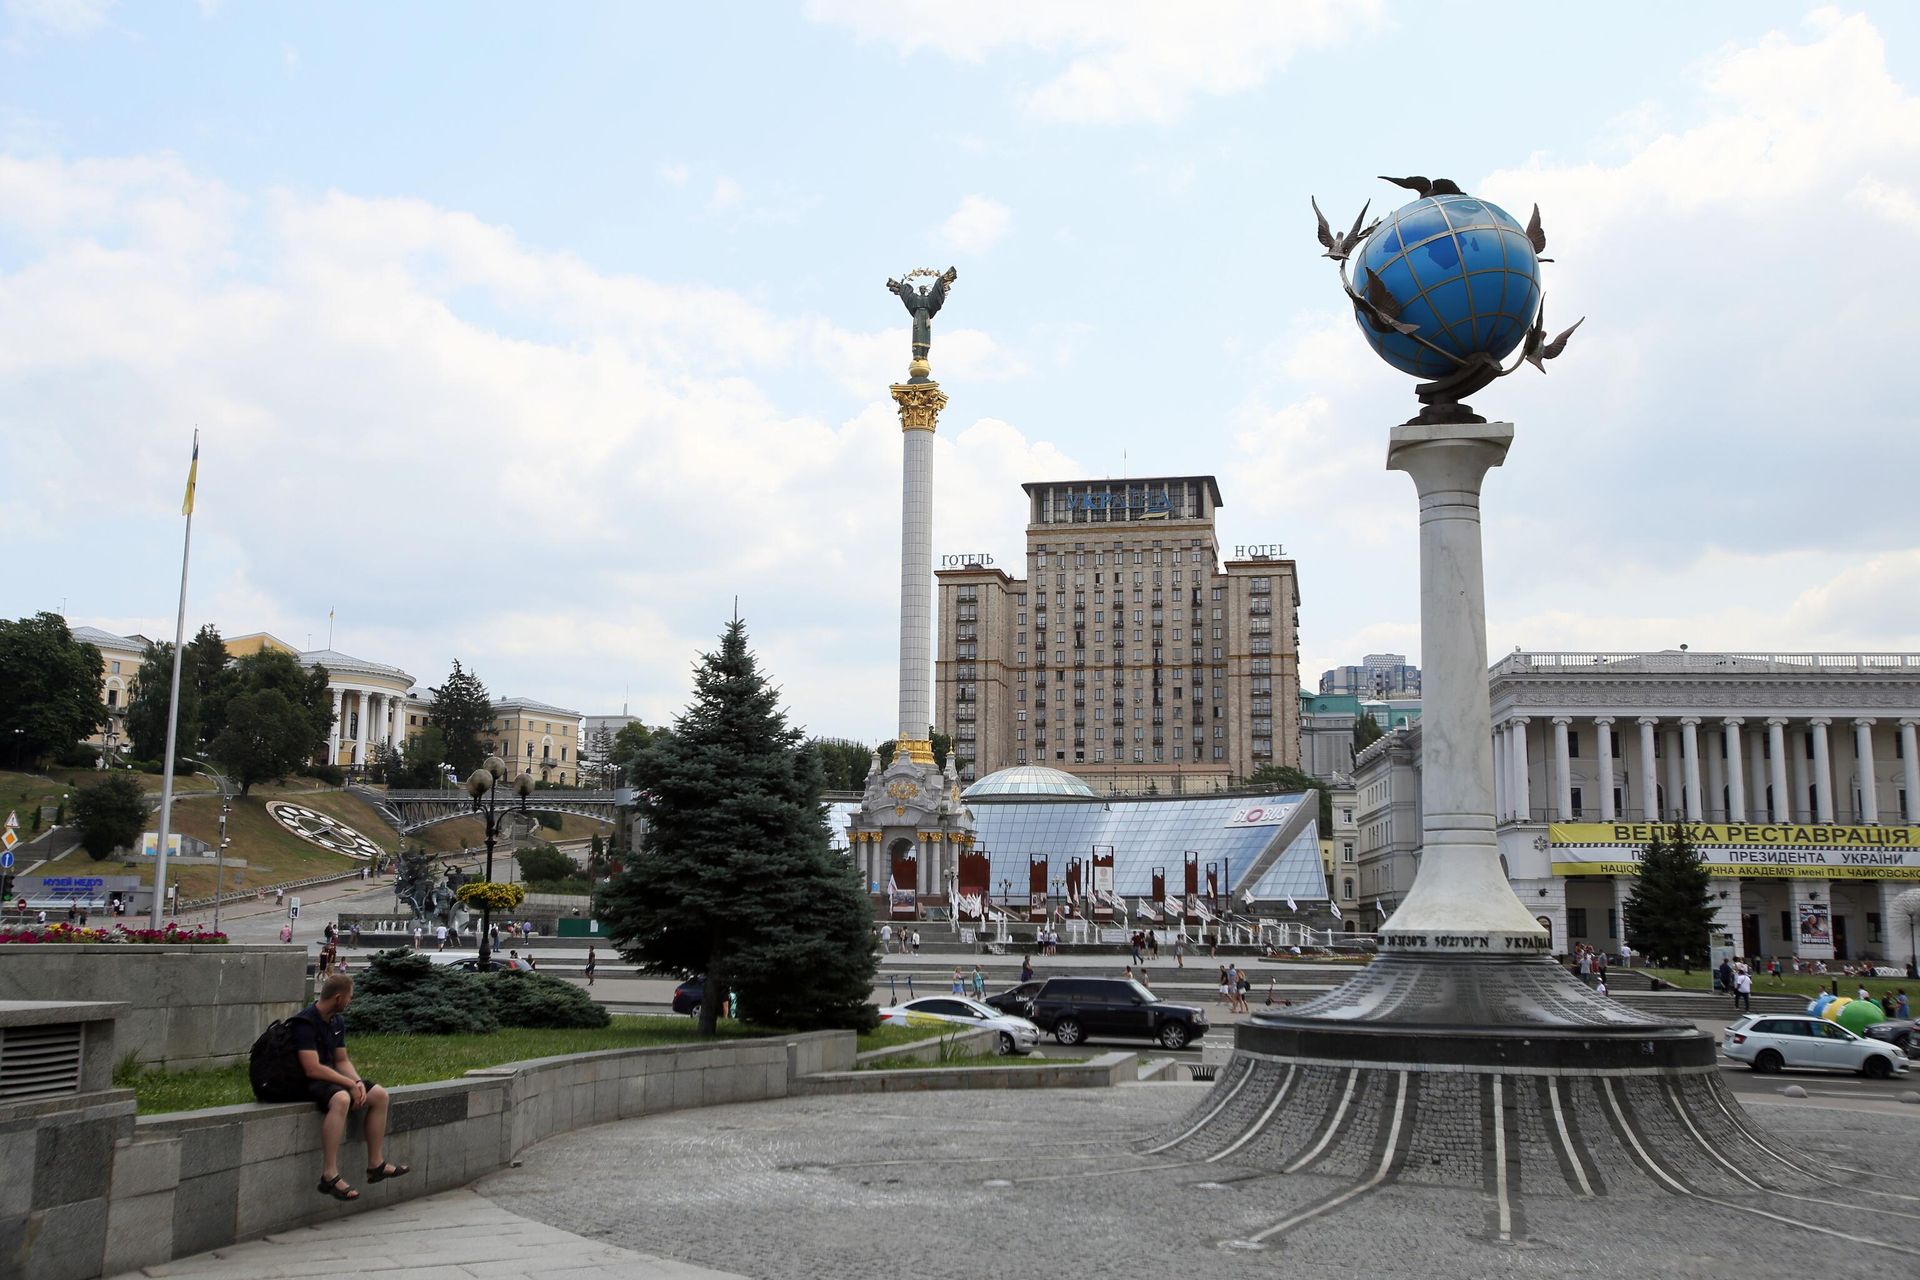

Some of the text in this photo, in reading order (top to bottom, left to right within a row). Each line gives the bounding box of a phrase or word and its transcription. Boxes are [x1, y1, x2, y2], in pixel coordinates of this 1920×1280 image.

[1065, 488, 1173, 512] УКРАЇНА
[1234, 544, 1288, 557] HOTEL
[941, 553, 995, 567] ГОТЕЛЬ
[1233, 807, 1290, 823] GLOBUS
[1614, 825, 1910, 846] ВЕЛИКА РЕСТАВРАЦІЯ
[1729, 851, 1904, 865] ПРЕЗИДЕНТА УКРАЇНИ
[1738, 866, 1795, 876] АКАДЕМІЯ
[1798, 868, 1825, 877] імені
